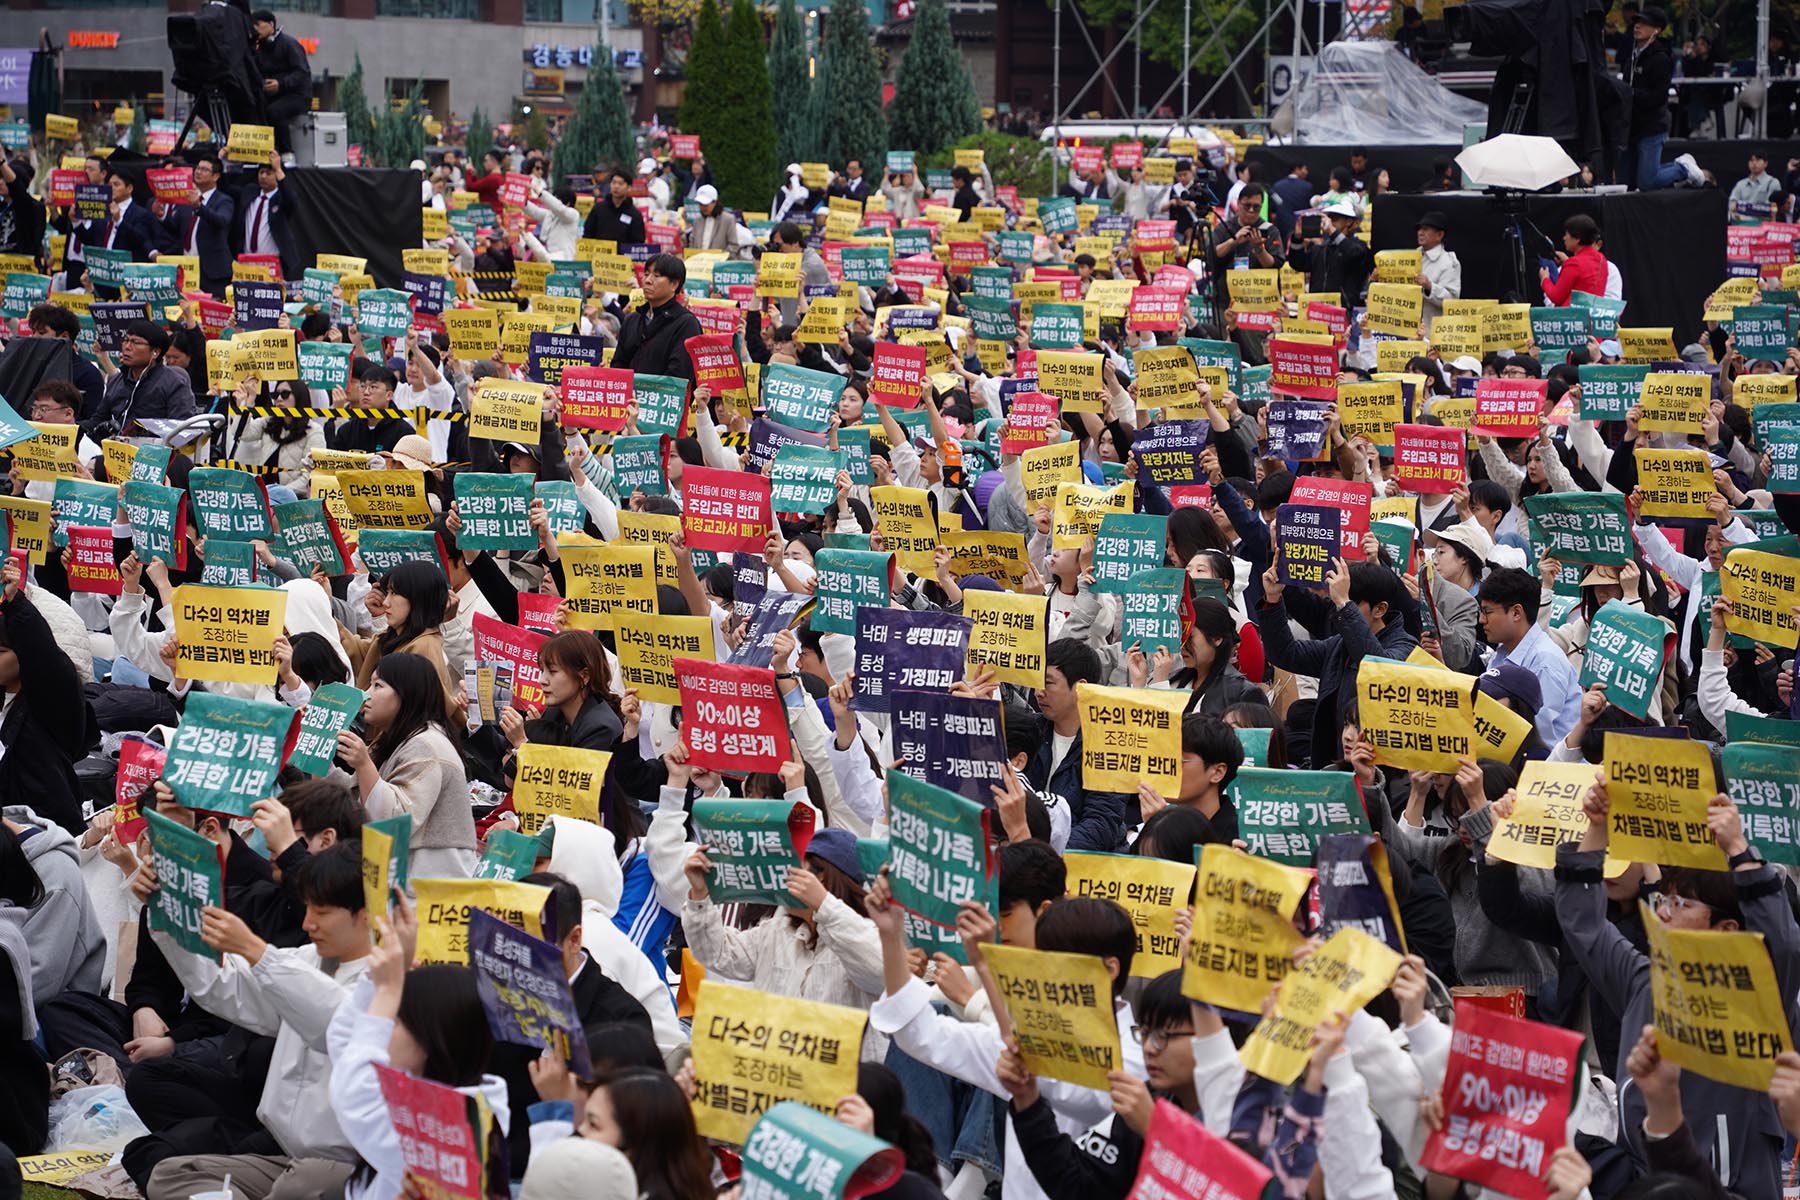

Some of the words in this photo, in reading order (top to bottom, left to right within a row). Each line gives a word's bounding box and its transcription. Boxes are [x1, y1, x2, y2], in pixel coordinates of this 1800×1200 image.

[533, 43, 640, 68] 경동대교
[1232, 278, 1251, 286] 다수의
[1373, 292, 1395, 306] 다수의
[1396, 294, 1417, 310] 역차별
[388, 315, 408, 329] 나라
[451, 320, 469, 329] 다수의
[1033, 316, 1058, 328] 건강한
[1533, 319, 1560, 334] 건강한
[237, 339, 260, 350] 다수의
[1061, 331, 1080, 342] 나라
[1766, 334, 1786, 345] 나라
[278, 361, 295, 371] 반대
[877, 367, 903, 380] 주입교육
[905, 370, 919, 381] 반대
[1043, 364, 1066, 374] 다수의
[1070, 365, 1094, 376] 역차별
[1277, 362, 1311, 373] 주입교육
[1313, 365, 1331, 376] 반대
[326, 371, 345, 383] 나라
[567, 389, 601, 402] 주입교육
[604, 392, 625, 404] 반대
[767, 379, 805, 398] 건강한
[1582, 380, 1618, 397] 건강한
[1648, 385, 1673, 396] 다수의
[1676, 386, 1702, 397] 역차별
[1480, 400, 1514, 413] 주입교육
[1517, 401, 1536, 413] 반대
[1584, 397, 1622, 412] 거룩한
[473, 414, 517, 428] 차별금지법
[520, 419, 538, 432] 반대
[660, 411, 678, 427] 나라
[1269, 409, 1285, 422] 낙태
[41, 433, 69, 448] 역차별
[1027, 459, 1050, 472] 다수의
[1052, 455, 1074, 468] 역차별
[1143, 452, 1195, 468] 앞당겨지는
[1401, 450, 1436, 466] 주입교육
[1439, 452, 1459, 467] 반대
[1642, 460, 1670, 472] 다수의
[1673, 460, 1704, 472] 역차별
[772, 463, 808, 481] 건강한
[1152, 465, 1194, 482] 인구소멸
[1658, 476, 1691, 487] 조장하는
[196, 490, 230, 510] 건강한
[350, 483, 381, 498] 다수의
[384, 483, 416, 498] 역차별
[688, 482, 718, 497] 자녀들에
[720, 486, 736, 499] 대한
[738, 487, 763, 501] 동성애
[770, 482, 807, 502] 거룩한
[808, 485, 834, 503] 나라
[55, 499, 83, 518] 건강한
[126, 503, 150, 523] 건강한
[368, 499, 403, 512] 조장하는
[458, 496, 497, 516] 건강한
[688, 499, 734, 518] 주입교육
[737, 504, 759, 521] 반대
[877, 502, 898, 516] 다수의
[899, 503, 924, 518] 역차별
[409, 511, 432, 525] 반대
[462, 518, 500, 537] 거룩한
[1293, 512, 1321, 525] 동성커플
[1537, 512, 1586, 531] 건강한
[913, 538, 936, 552] 반대
[1097, 536, 1129, 559] 건강한
[1285, 542, 1329, 562] 앞당겨지는
[1549, 532, 1590, 551] 거룩한
[1597, 534, 1626, 554] 나라
[76, 549, 114, 564] 주입교육
[71, 564, 119, 581] 개정교과서
[573, 563, 601, 578] 다수의
[604, 563, 644, 579] 역차별
[1288, 564, 1323, 582] 인구소멸
[1730, 562, 1758, 582] 다수의
[1761, 569, 1796, 592] 역차별
[590, 581, 625, 596] 조장하는
[817, 570, 852, 593] 건강한
[1125, 593, 1159, 613] 건강한
[1741, 586, 1777, 603] 조장하는
[184, 605, 222, 623] 다수의
[228, 609, 270, 626] 역차별
[971, 609, 1000, 625] 다수의
[1003, 613, 1035, 631] 역차별
[1773, 611, 1798, 631] 반대
[203, 627, 249, 643] 조장하는
[863, 624, 888, 643] 낙태
[906, 628, 962, 647] 생명파괴
[980, 630, 1018, 647] 조장하는
[1126, 618, 1159, 639] 거룩한
[1589, 620, 1627, 654] 건강한
[620, 628, 653, 646] 다수의
[657, 634, 700, 652] 역차별
[179, 644, 245, 664] 차별금지법
[1013, 653, 1041, 671] 반대
[861, 654, 884, 672] 동성
[900, 668, 953, 688] 가정파괴
[709, 680, 738, 697] 감염의
[740, 683, 775, 700] 원인은
[859, 673, 883, 697] 커플
[1614, 666, 1647, 699] 나라
[1369, 683, 1411, 700] 다수의
[1417, 687, 1459, 709] 역차별
[302, 706, 328, 730] 건강한
[697, 699, 761, 729] 90%이상
[899, 711, 927, 730] 낙태
[943, 714, 996, 737] 생명파괴
[1089, 705, 1126, 725] 다수의
[1130, 707, 1170, 729] 역차별
[1389, 707, 1437, 728] 조장하는
[176, 724, 239, 754] 건강한
[690, 728, 717, 753] 동성
[722, 734, 777, 758] 성관계
[1104, 730, 1148, 749] 조장하는
[1363, 728, 1433, 751] 차별금지법
[1437, 734, 1469, 755] 반대
[901, 741, 926, 761] 동성
[947, 758, 1003, 780] 가정파괴
[1084, 751, 1141, 773] 차별금지법
[1147, 754, 1178, 777] 반대
[168, 758, 230, 790] 거룩한
[229, 771, 268, 797] 나라
[521, 765, 555, 784] 다수의
[557, 767, 593, 791] 역차별
[1611, 760, 1650, 783] 다수의
[1653, 763, 1700, 790] 역차별
[1528, 780, 1581, 800] 다수의
[1729, 777, 1785, 808] 건강한
[536, 792, 572, 810] 조장하는
[1632, 791, 1681, 814] 조장하는
[1244, 800, 1300, 826] 건강한
[890, 805, 929, 851] 건강한
[1613, 813, 1682, 842] 차별금지법
[1247, 833, 1312, 856] 거룩한
[713, 862, 755, 891] 거룩한
[889, 845, 931, 893] 거룩한
[1078, 878, 1121, 900] 다수의
[1128, 882, 1175, 907] 역차별
[1151, 934, 1180, 958] 반대
[1679, 960, 1756, 993] 역차별
[998, 973, 1040, 1002] 다수의
[1043, 982, 1097, 1008] 역차별
[708, 1014, 766, 1051] 다수의
[778, 1029, 841, 1065] 역차별
[1733, 1030, 1783, 1061] 반대
[1081, 1044, 1114, 1071] 반대
[1486, 1039, 1524, 1071] 감염의
[733, 1054, 805, 1090] 조장하는
[747, 1120, 807, 1175] 건강한
[1480, 1125, 1546, 1177] 성관계
